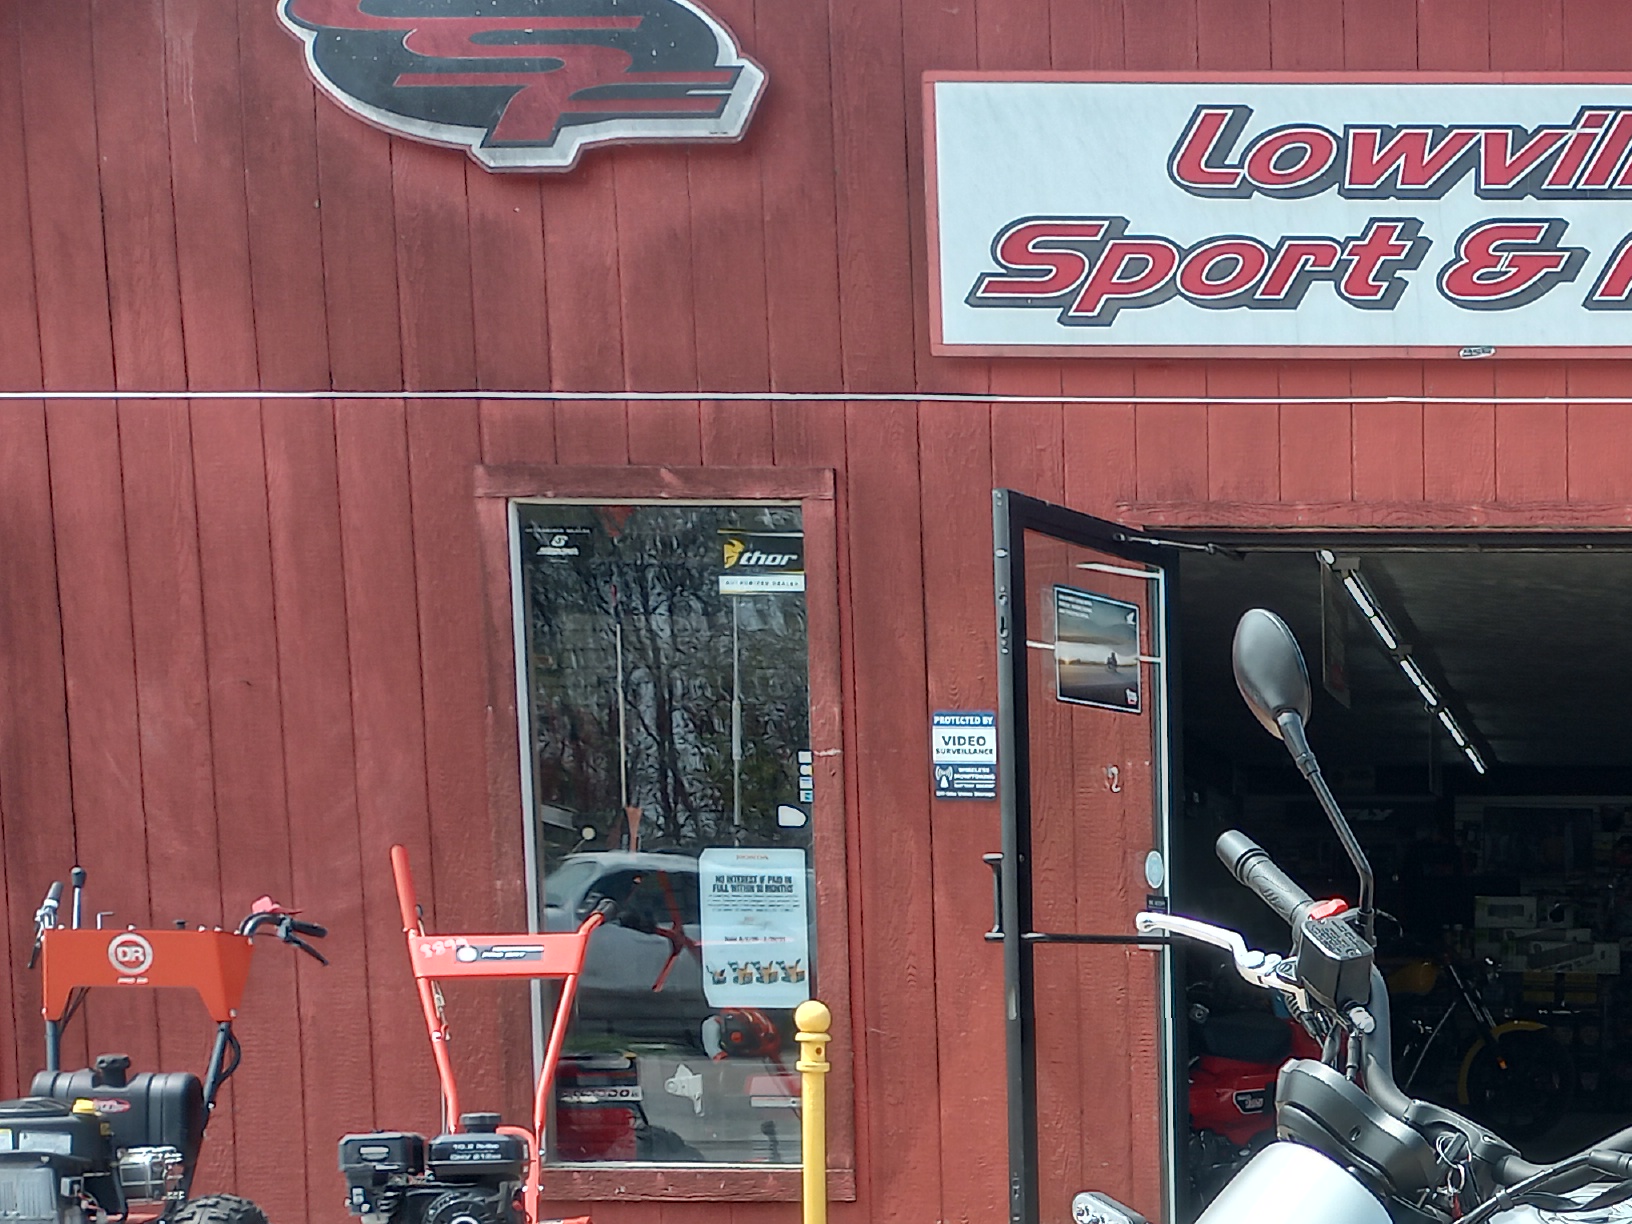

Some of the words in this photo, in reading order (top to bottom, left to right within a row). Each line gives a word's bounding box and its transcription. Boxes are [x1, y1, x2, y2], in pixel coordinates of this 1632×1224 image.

[968, 215, 1432, 327] Sport
[1440, 218, 1591, 311] &
[738, 550, 799, 567] thor
[933, 715, 981, 725] PROTECTED
[982, 716, 994, 725] BY
[941, 735, 987, 747] VIDEO
[116, 946, 145, 962] DR
